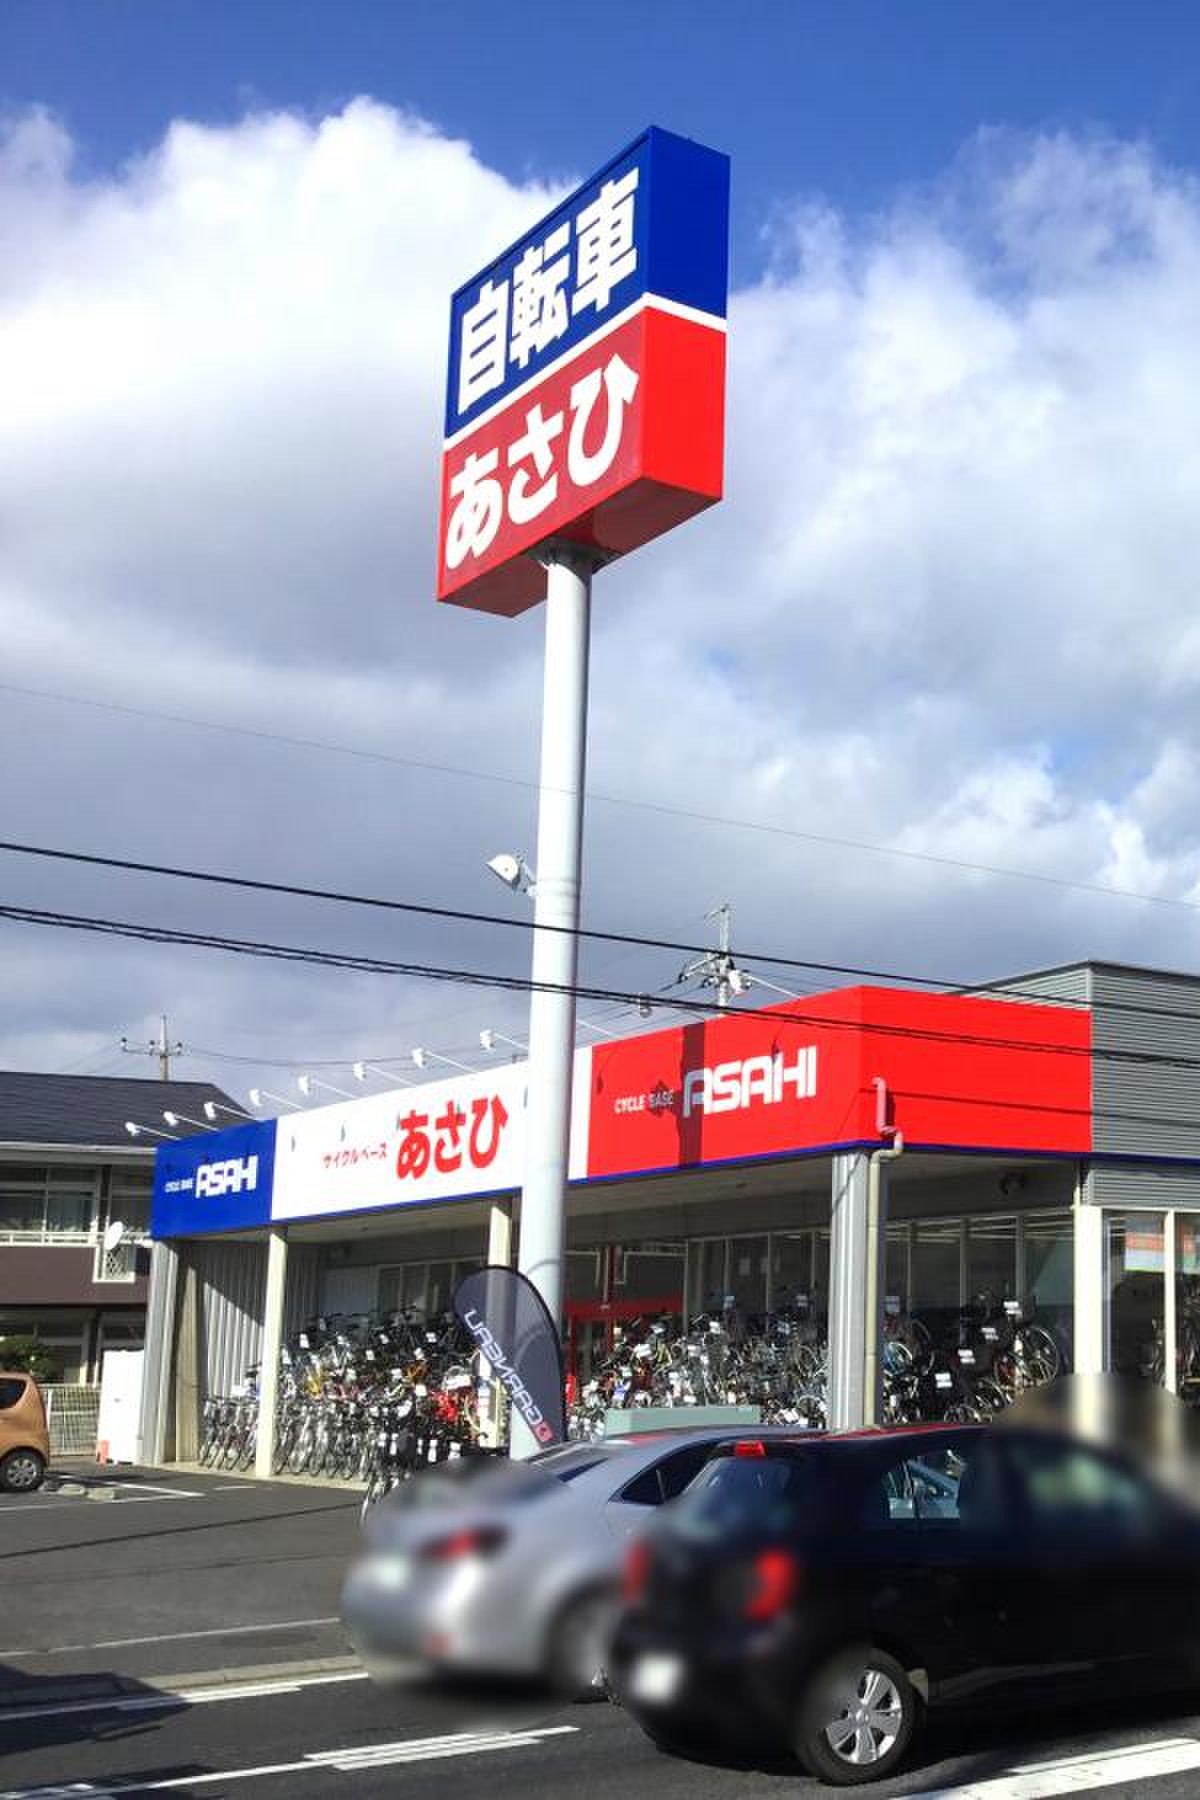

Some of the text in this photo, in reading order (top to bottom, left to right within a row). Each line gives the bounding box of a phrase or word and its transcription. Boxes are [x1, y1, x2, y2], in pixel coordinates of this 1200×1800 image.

[458, 167, 639, 415] 自転車
[446, 353, 640, 569] あさひ
[682, 1045, 817, 1118] ASAHI
[195, 1155, 258, 1199] ASAHI
[396, 1094, 509, 1180] あさひ
